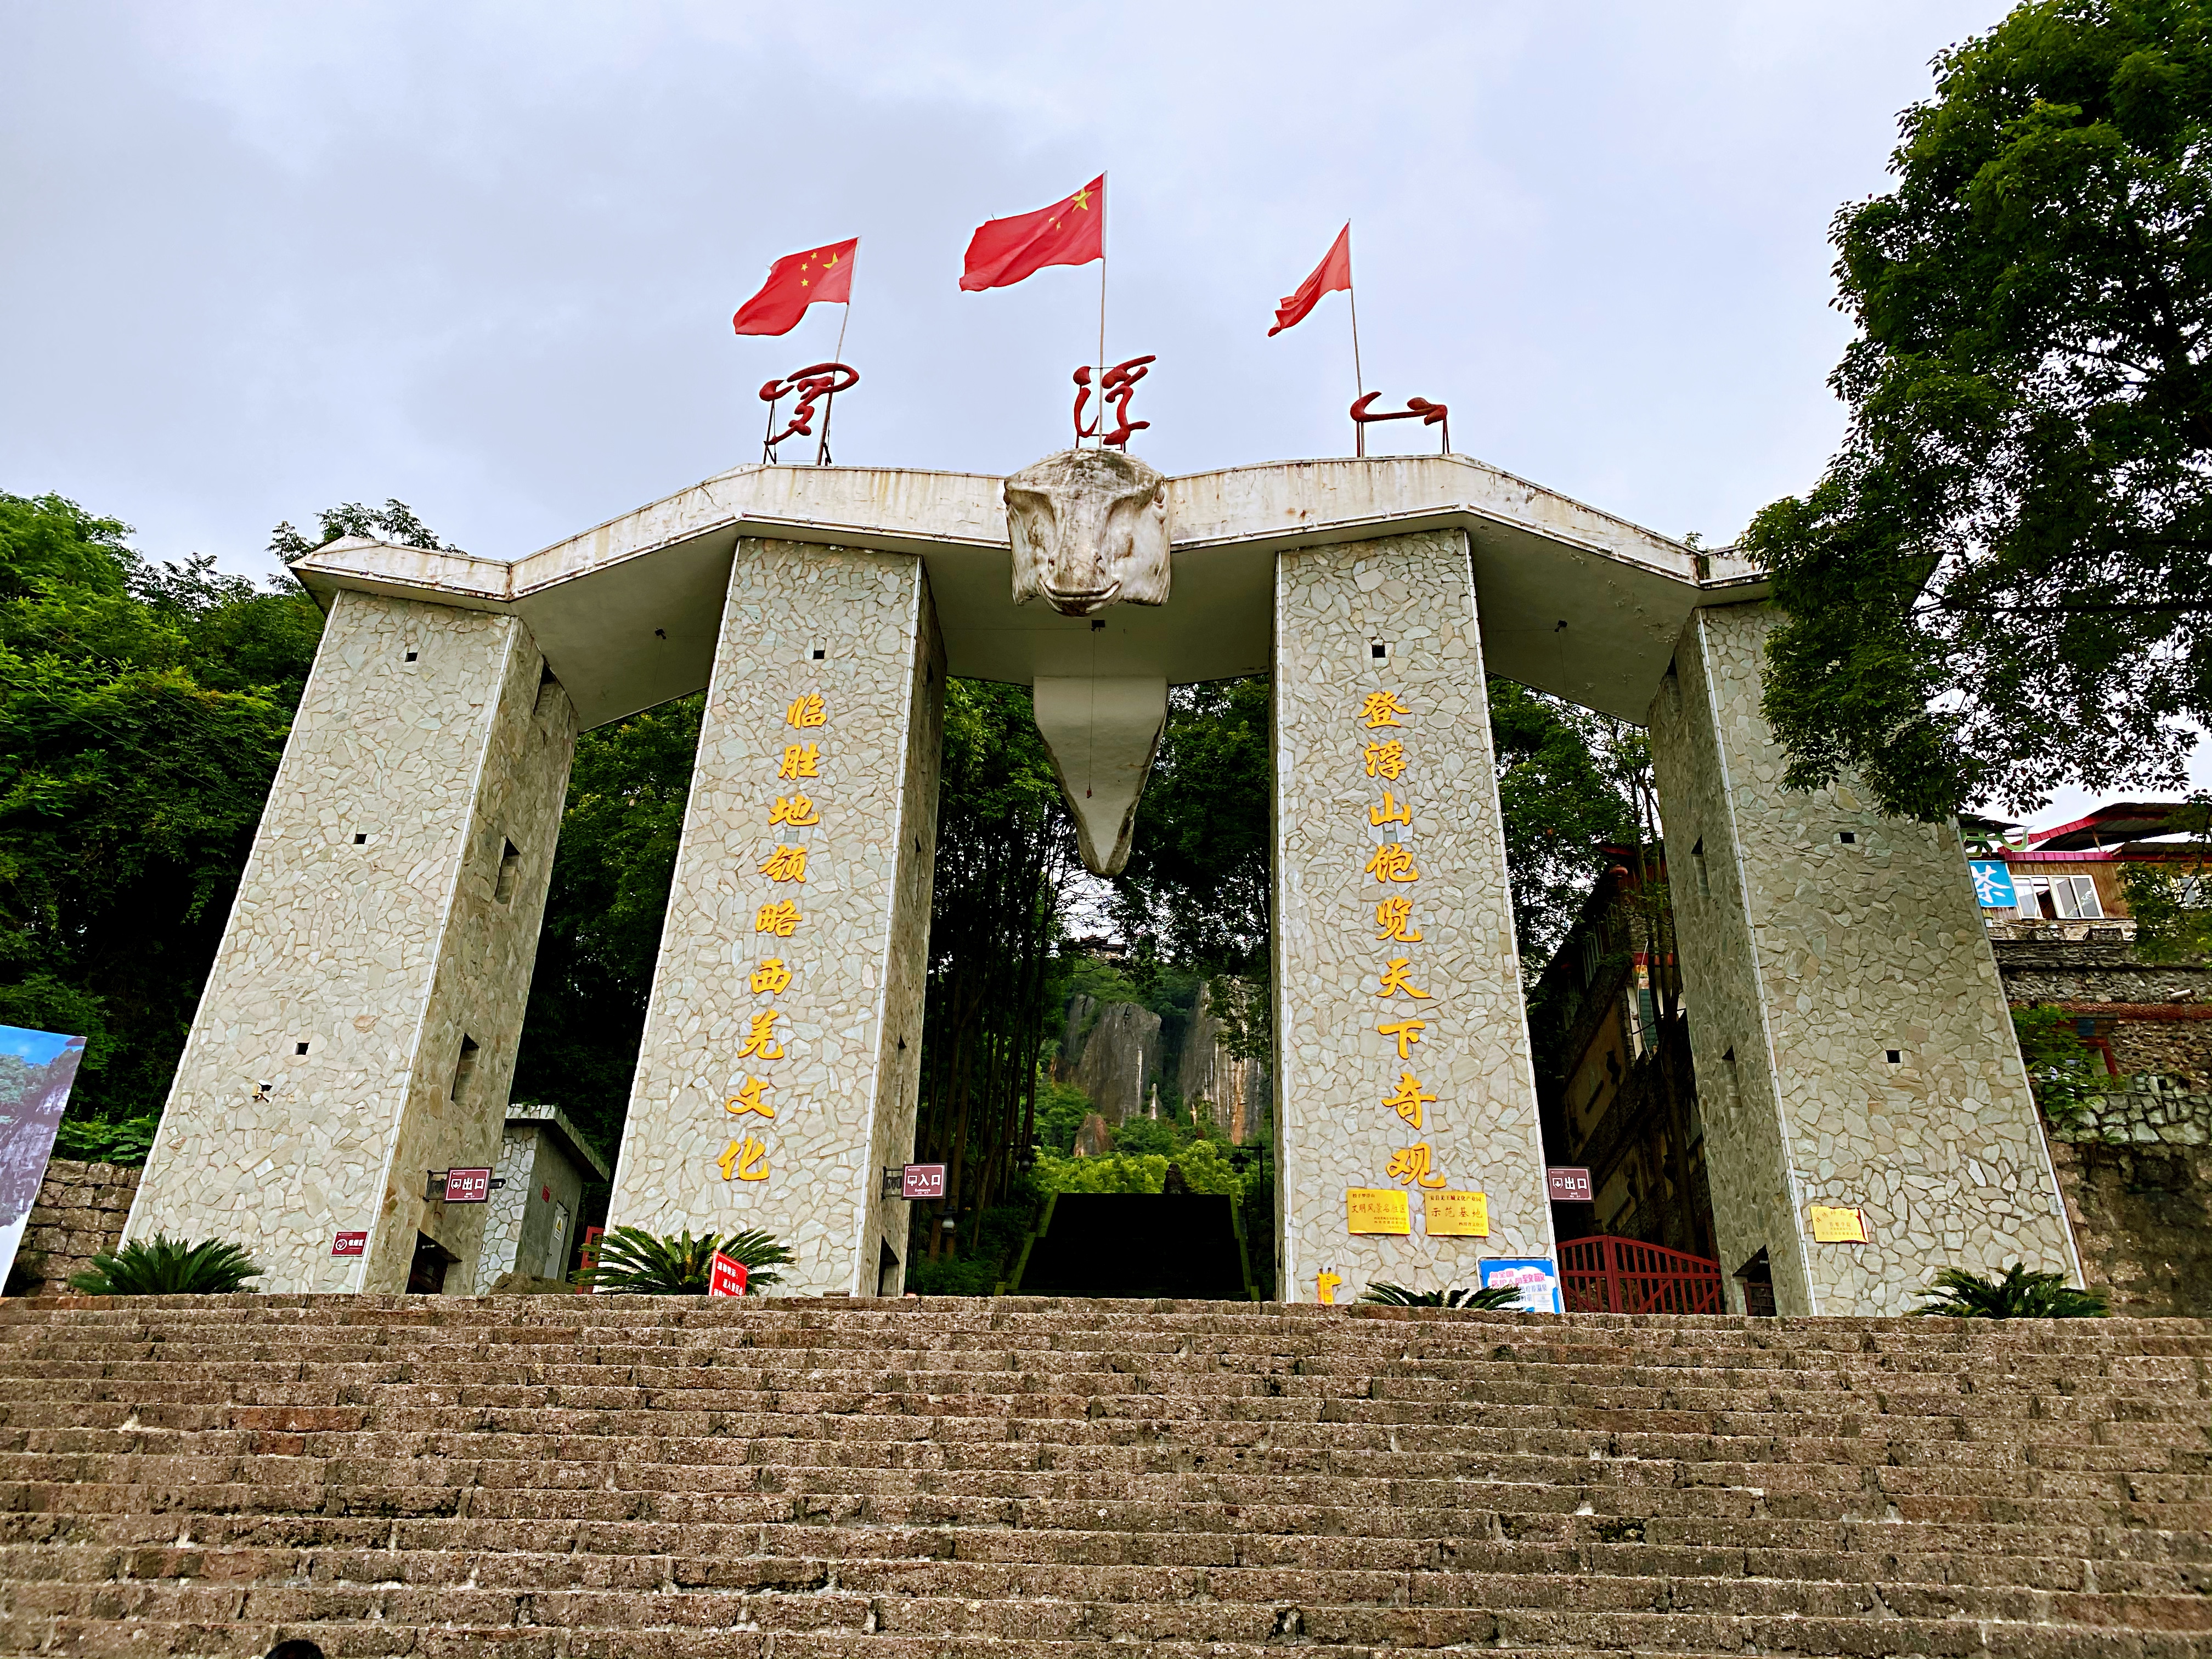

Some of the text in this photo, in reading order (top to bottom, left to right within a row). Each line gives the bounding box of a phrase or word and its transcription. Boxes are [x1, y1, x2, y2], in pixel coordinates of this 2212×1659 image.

[718, 693, 827, 1181] 临胜地领略西羌文化
[1358, 691, 1446, 1188] 登浮山饱览天下奇观
[462, 1177, 485, 1190] 出口
[918, 1173, 941, 1187] 入口
[1564, 1176, 1587, 1190] 出口
[1351, 1203, 1406, 1214] 文明风景名胜区
[1431, 1206, 1483, 1218] 示范基地
[1491, 1270, 1514, 1279] 向全国
